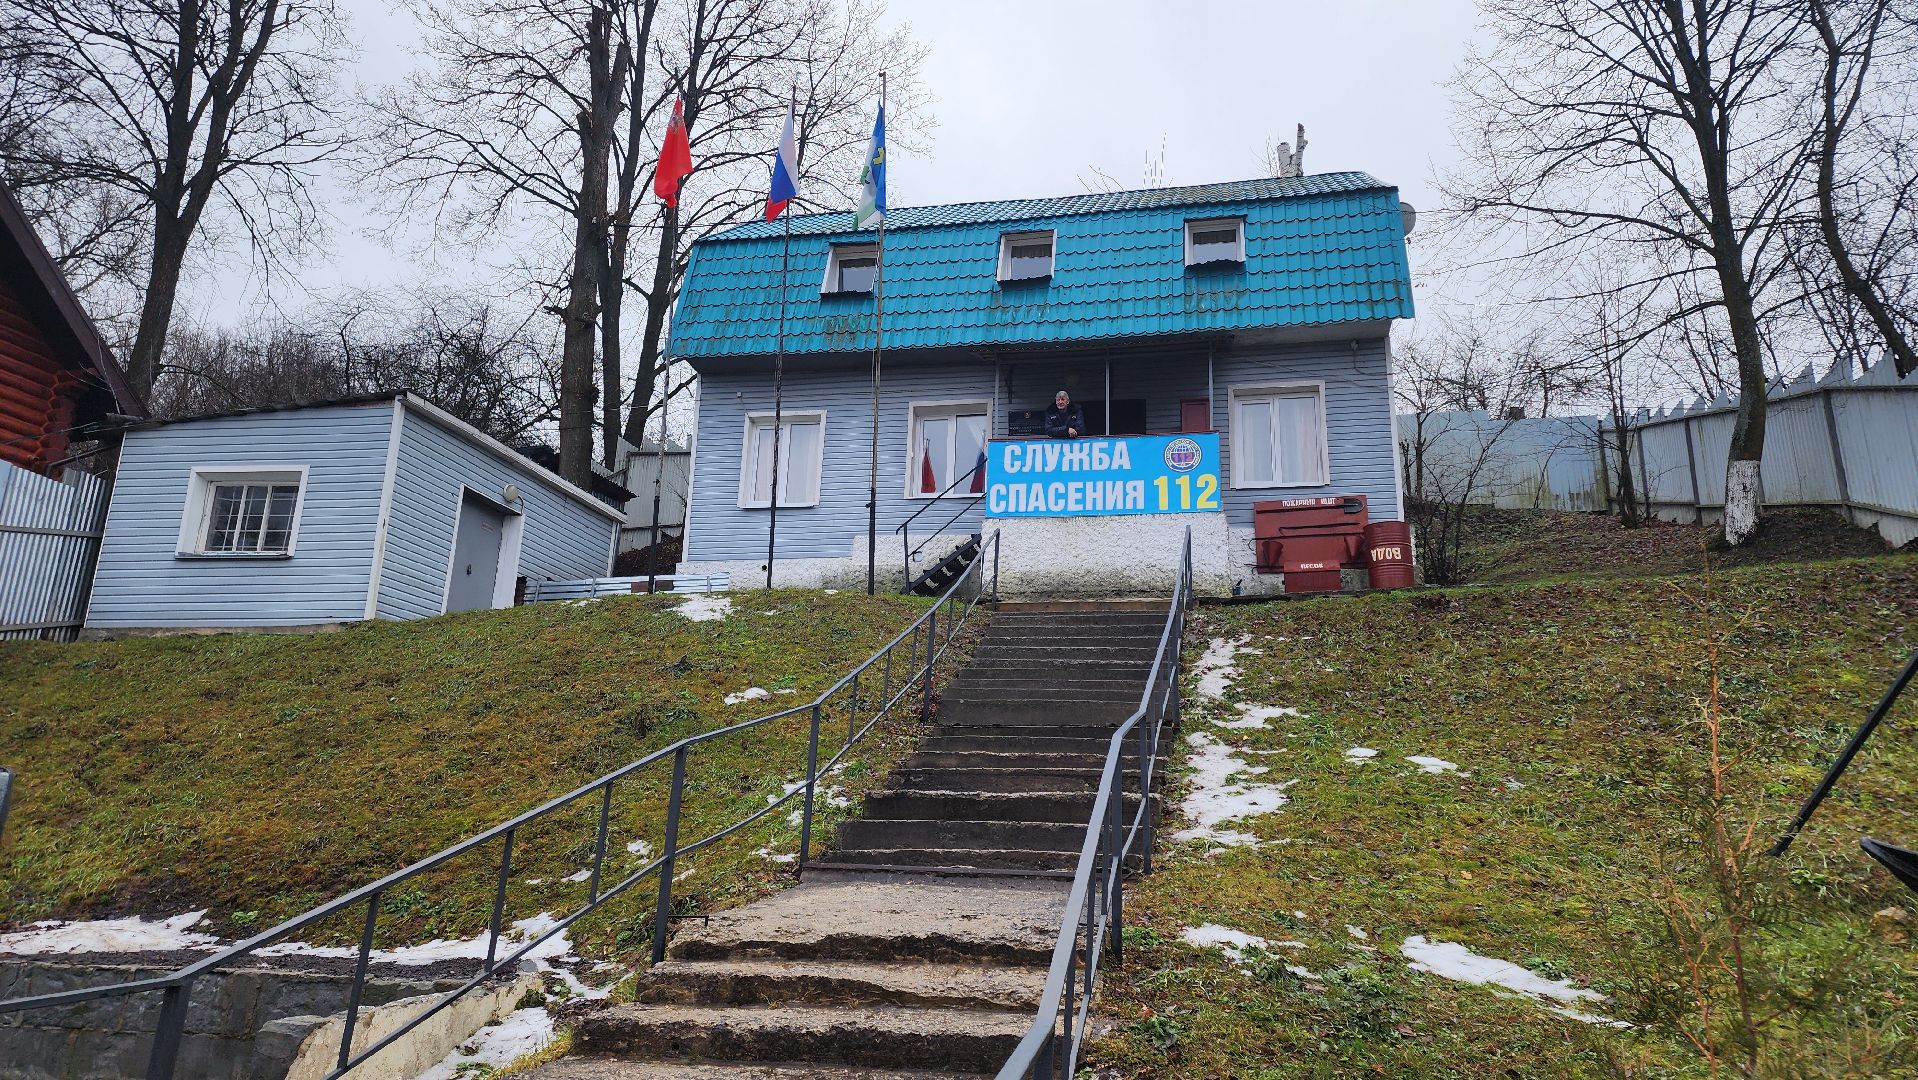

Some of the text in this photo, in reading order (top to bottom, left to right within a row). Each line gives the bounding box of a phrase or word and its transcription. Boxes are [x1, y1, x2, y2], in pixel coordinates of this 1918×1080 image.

[1003, 440, 1132, 473] СЛУЖБА
[1172, 452, 1193, 463] 112
[989, 473, 1218, 513] СПАСЕНИЯ 112
[1370, 547, 1402, 562] ВОДА
